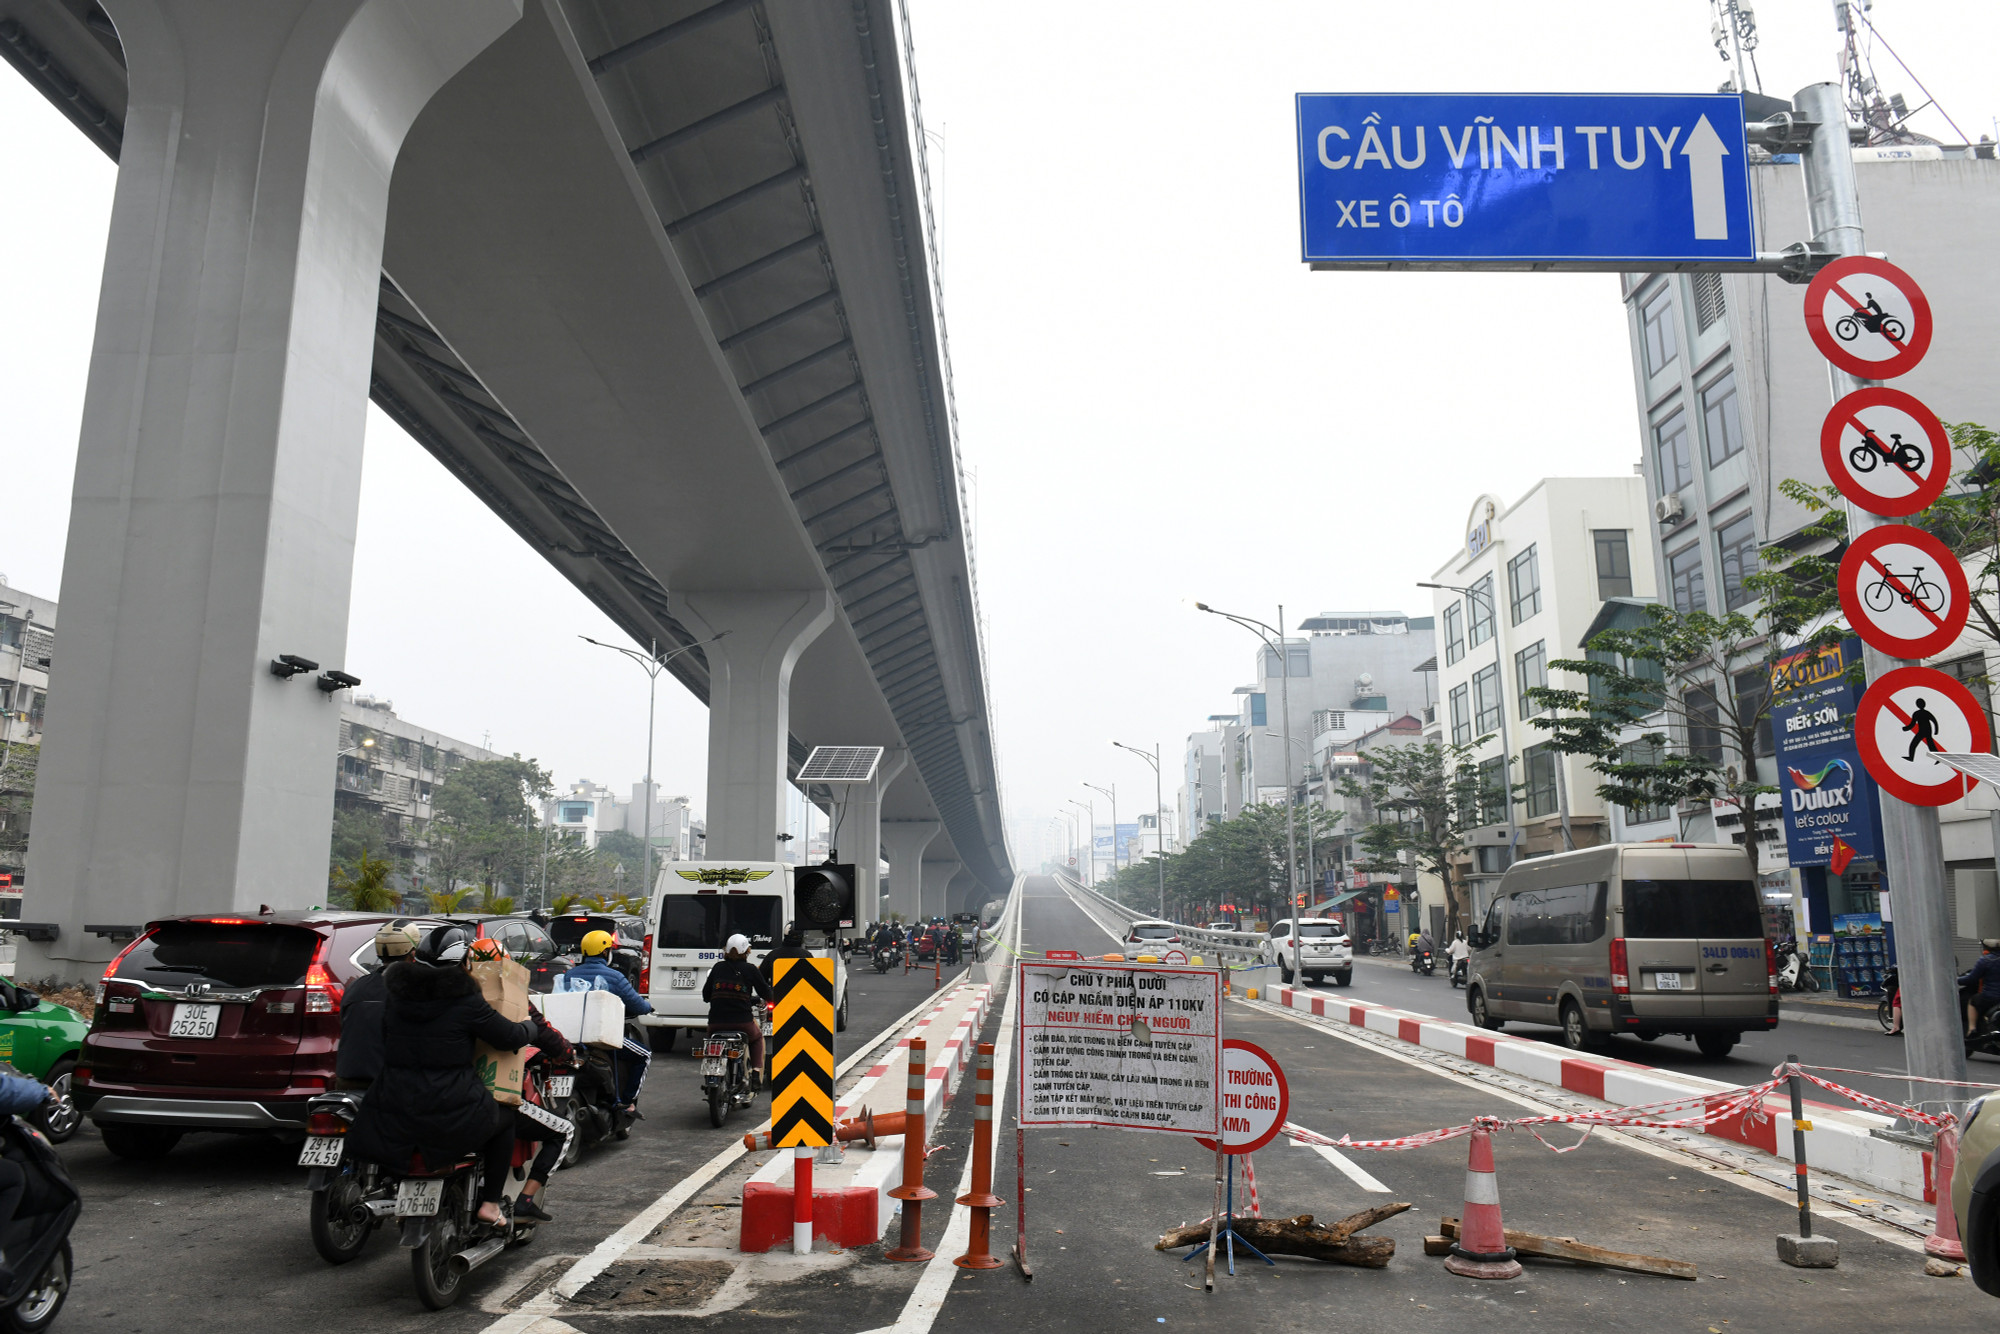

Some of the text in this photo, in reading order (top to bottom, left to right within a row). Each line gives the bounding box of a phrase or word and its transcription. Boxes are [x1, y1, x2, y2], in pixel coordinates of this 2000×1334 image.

[1317, 112, 1681, 170] CẦU VĨNH TUY
[1336, 193, 1464, 228] XE Ô TÔ
[1814, 706, 1839, 727] SƠN
[1790, 787, 1848, 812] Dulux
[1795, 813, 1815, 828] let's
[1816, 812, 1849, 826] colour
[1703, 947, 1727, 959] 34LD
[678, 971, 691, 979] 89D
[1070, 972, 1166, 991] CHÚ Ý PHÍA DƯỚI
[1034, 990, 1049, 1003] CÓ
[1052, 990, 1075, 1005] CÁP
[1149, 996, 1164, 1009] ÁP
[1168, 998, 1204, 1012] 110KV
[184, 1006, 209, 1020] 30E
[1048, 1011, 1080, 1023] NGUY
[1153, 1016, 1191, 1030] NGƯỜI
[171, 1021, 215, 1036] 252.50
[1128, 1051, 1151, 1060] TRONG
[1228, 1068, 1273, 1086] TRƯỜNG
[1224, 1093, 1276, 1110] THI CÔNG
[300, 1151, 339, 1165] 274.59
[413, 1182, 427, 1197] 32
